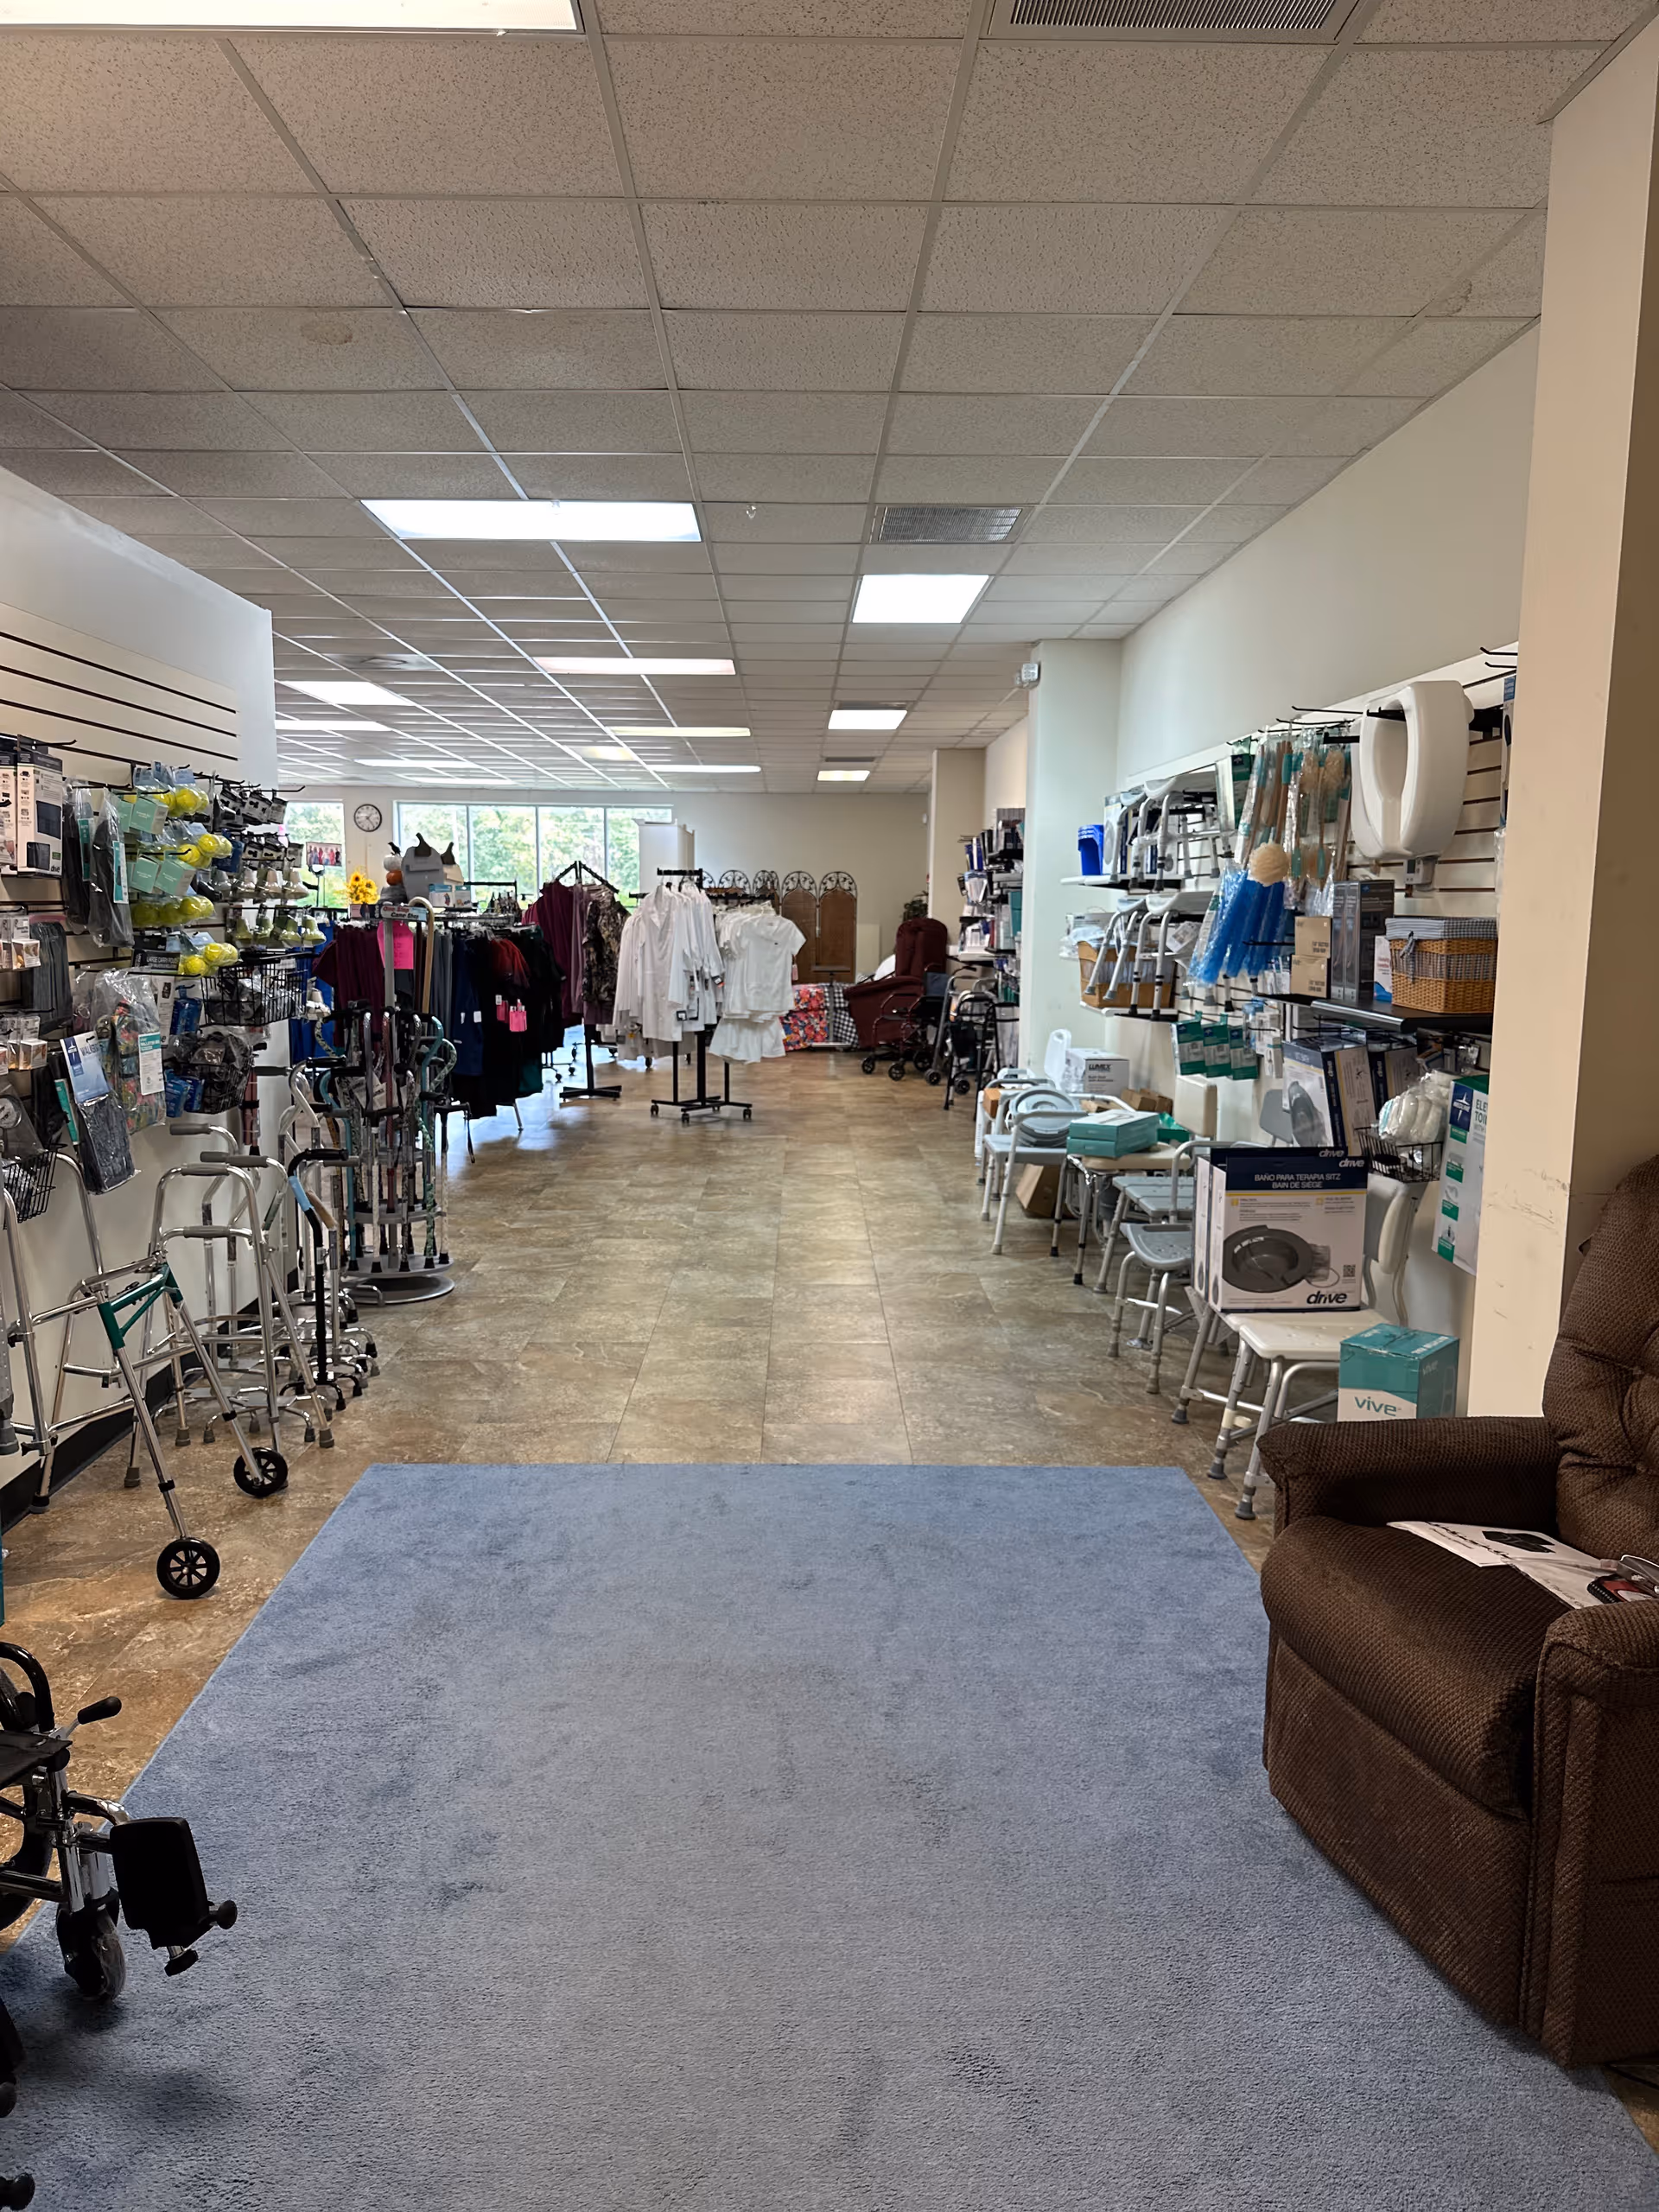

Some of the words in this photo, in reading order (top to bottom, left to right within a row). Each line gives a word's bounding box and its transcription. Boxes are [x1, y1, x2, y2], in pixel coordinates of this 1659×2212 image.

[1319, 1149, 1344, 1158] drive
[1339, 1159, 1364, 1167] drive
[1255, 1173, 1275, 1181] BAÑO
[1306, 1290, 1347, 1305] drive
[1354, 1396, 1397, 1417] vive
